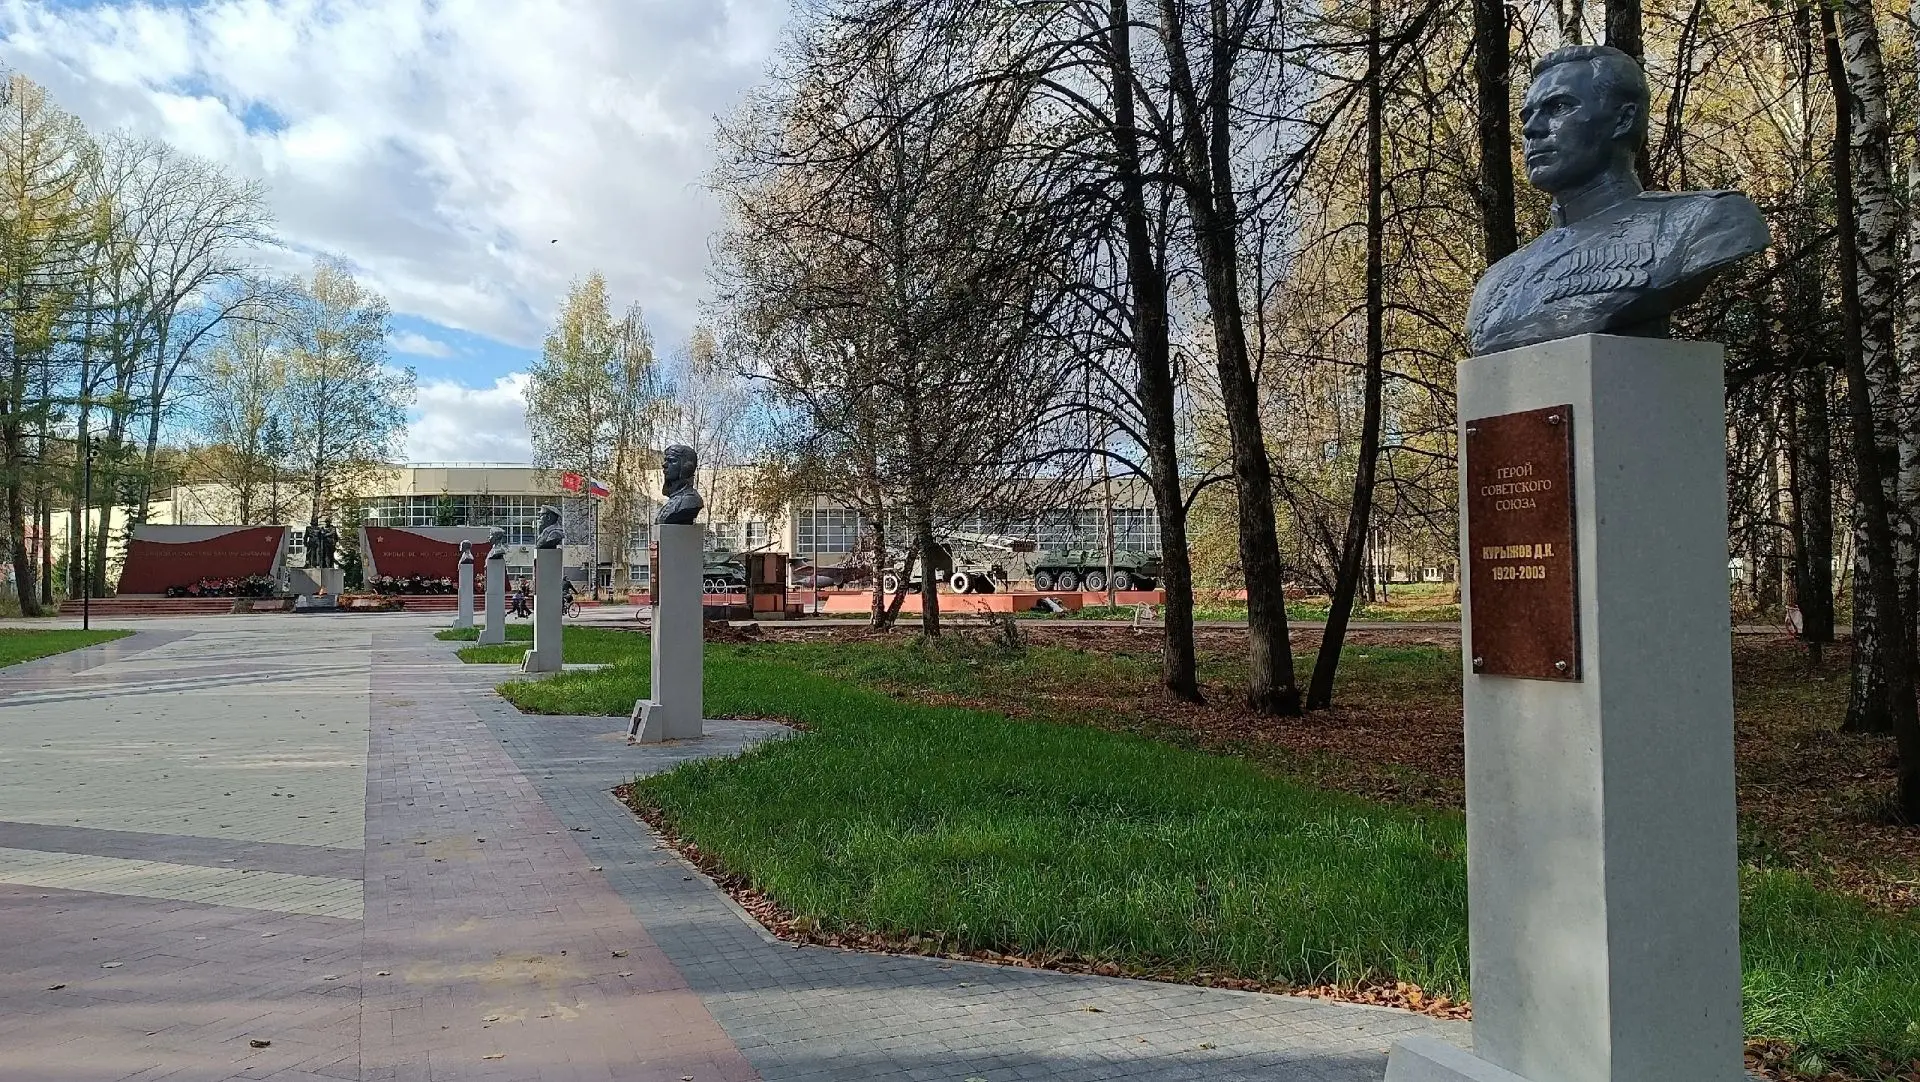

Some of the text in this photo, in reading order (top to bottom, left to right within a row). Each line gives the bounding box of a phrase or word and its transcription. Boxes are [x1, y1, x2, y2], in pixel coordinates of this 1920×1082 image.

[1497, 462, 1533, 479] ГЕРОЙ
[1481, 479, 1552, 496] СОВЕТСКОГО
[1495, 498, 1536, 511] СОЮЗА
[1482, 543, 1554, 560] КУРЫЖОВ Д.К.
[1491, 565, 1546, 581] 1920-2003
